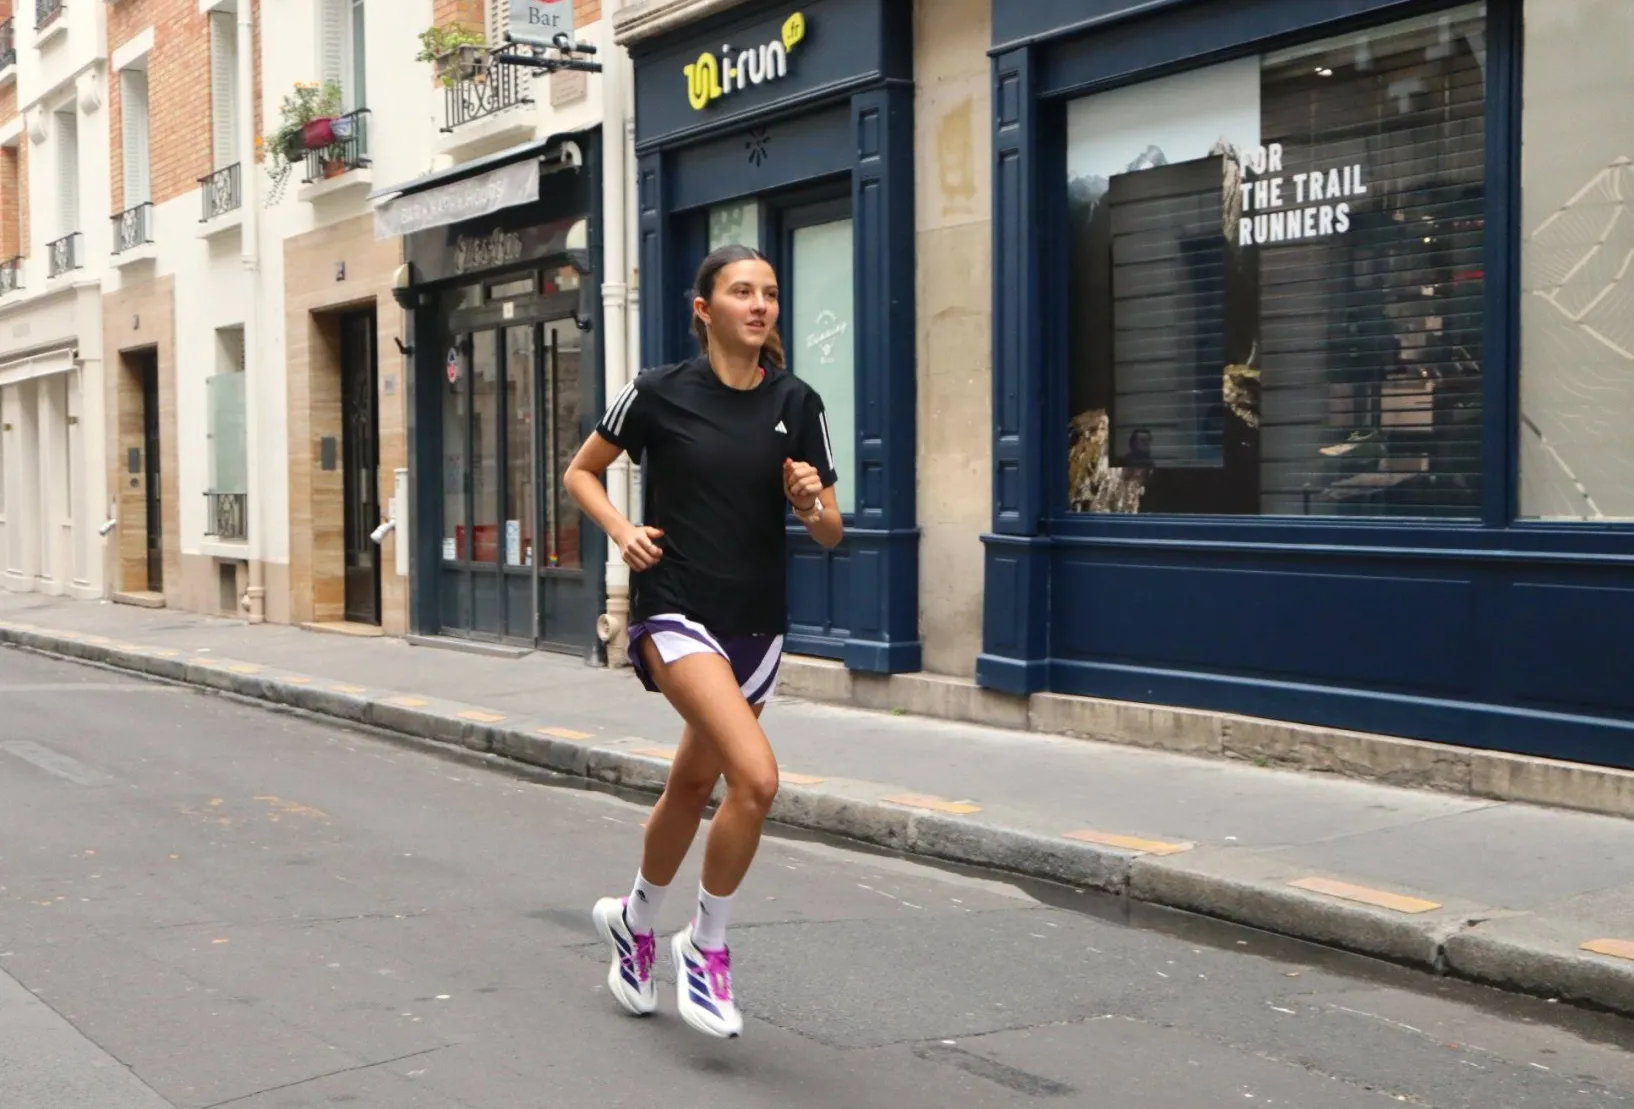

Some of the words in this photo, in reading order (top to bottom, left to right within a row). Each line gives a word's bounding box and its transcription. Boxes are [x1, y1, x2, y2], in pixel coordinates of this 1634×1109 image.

[528, 6, 560, 27] Bar
[1240, 142, 1283, 179] FOR
[1240, 177, 1283, 212] THE
[1292, 164, 1367, 203] TRAIL
[1239, 202, 1350, 247] RUNNERS
